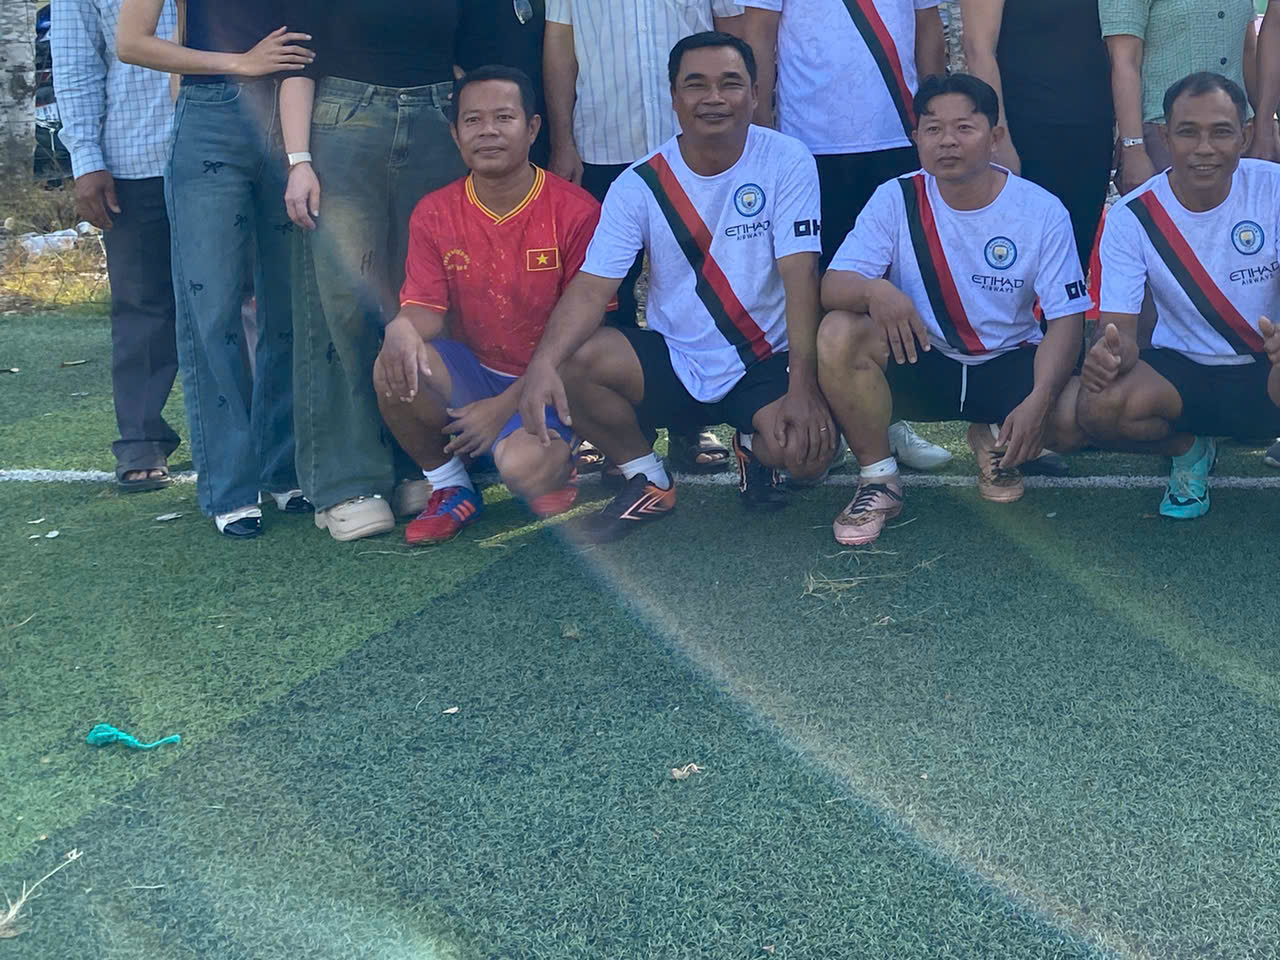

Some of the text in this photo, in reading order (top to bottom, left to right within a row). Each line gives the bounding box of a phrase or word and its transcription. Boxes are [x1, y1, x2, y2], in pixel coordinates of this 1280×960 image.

[725, 220, 770, 236] ETIHAD
[1230, 261, 1280, 281] ETIHAD
[971, 274, 1024, 289] ETIHAD
